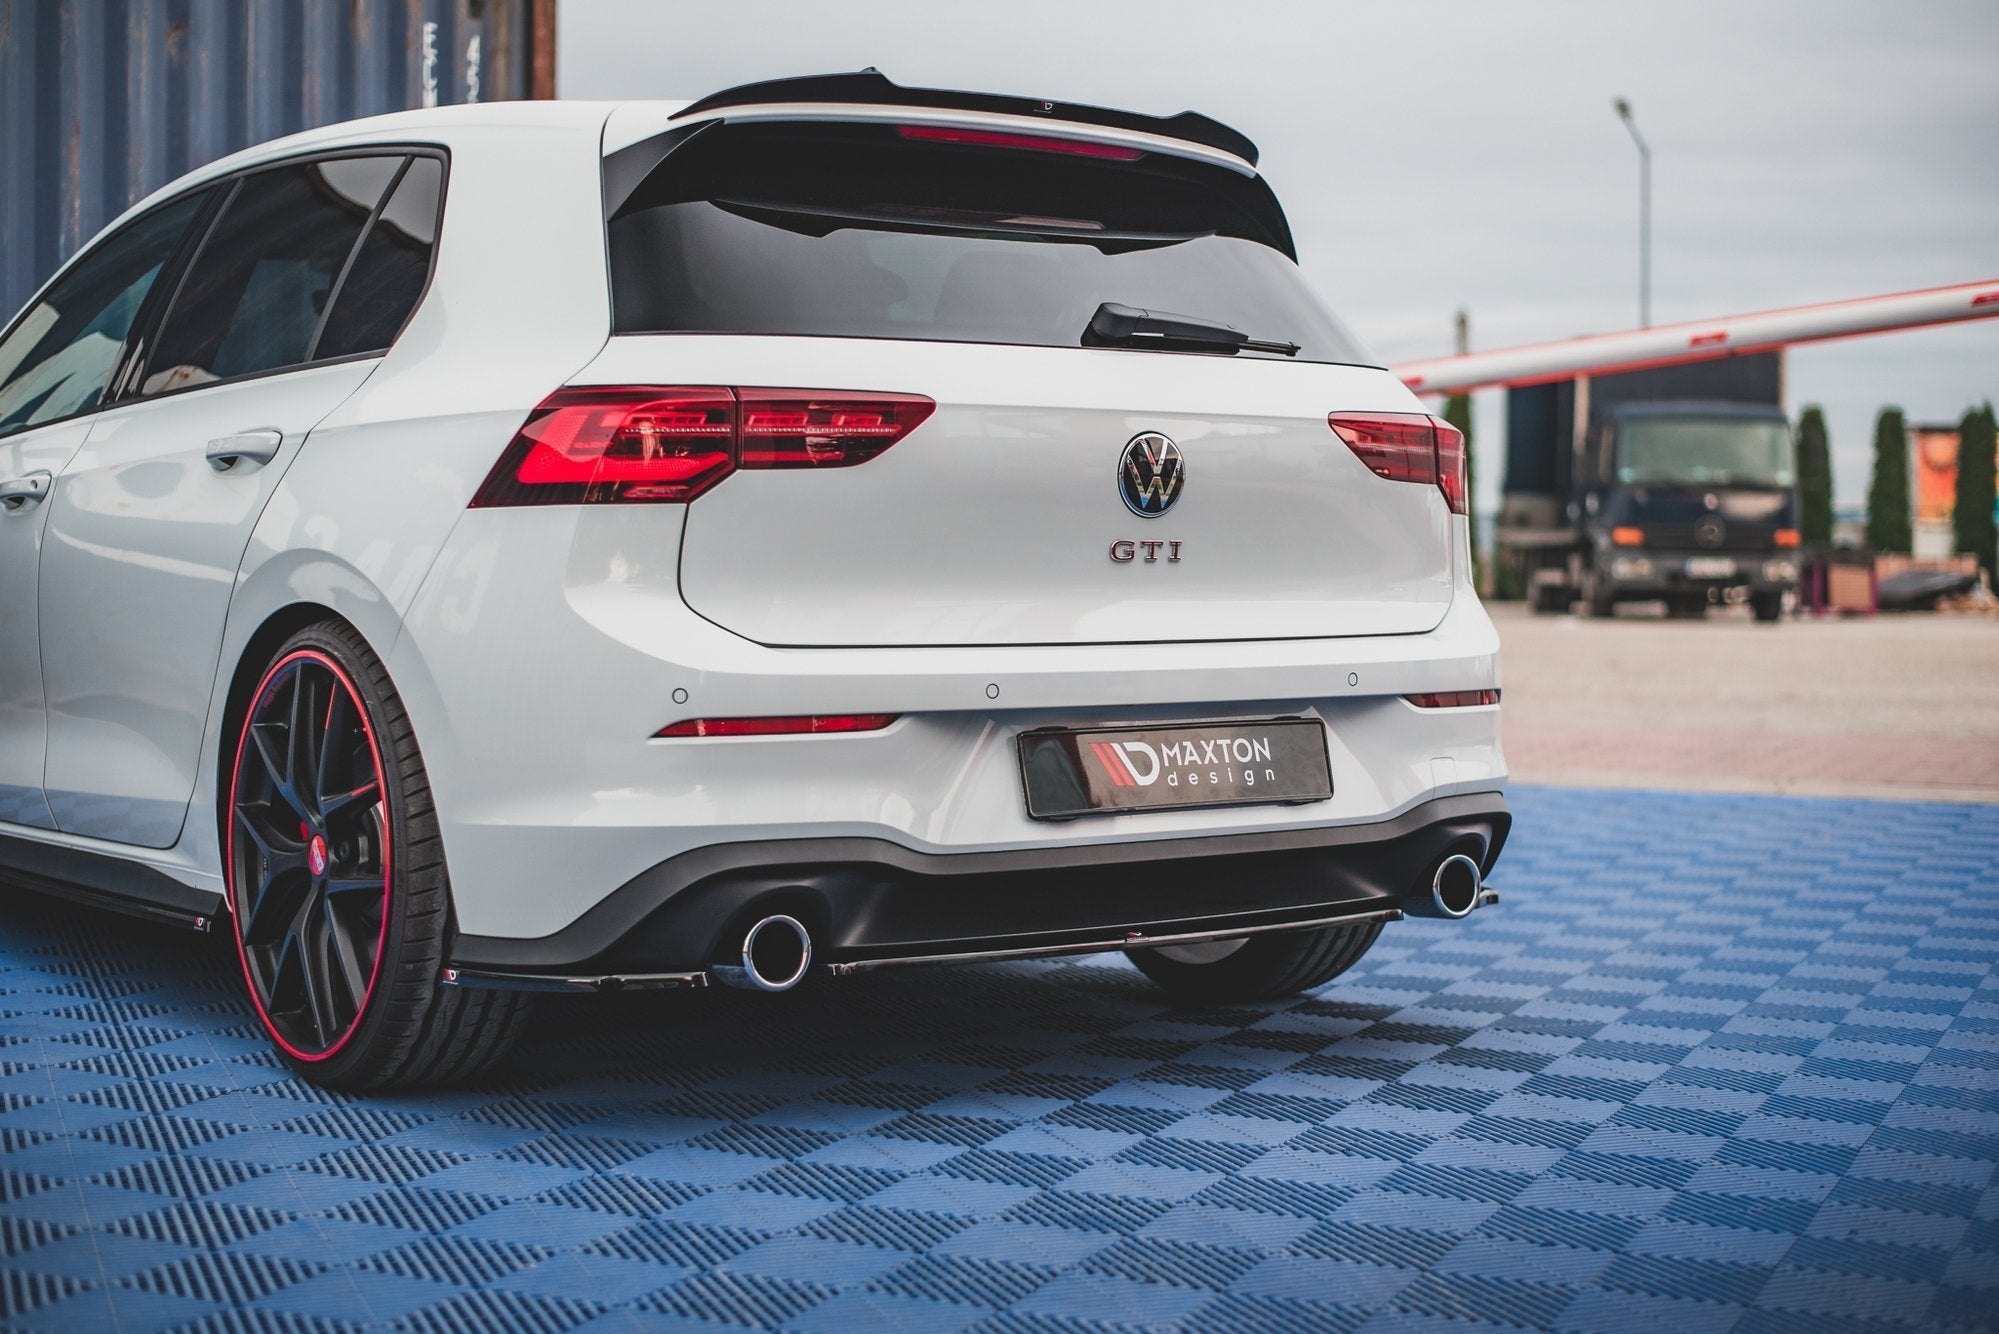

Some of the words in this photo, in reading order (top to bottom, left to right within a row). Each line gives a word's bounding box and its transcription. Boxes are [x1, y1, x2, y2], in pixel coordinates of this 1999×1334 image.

[1109, 539, 1183, 563] GTI
[1160, 737, 1272, 767] MAXTON
[1167, 768, 1275, 787] design
